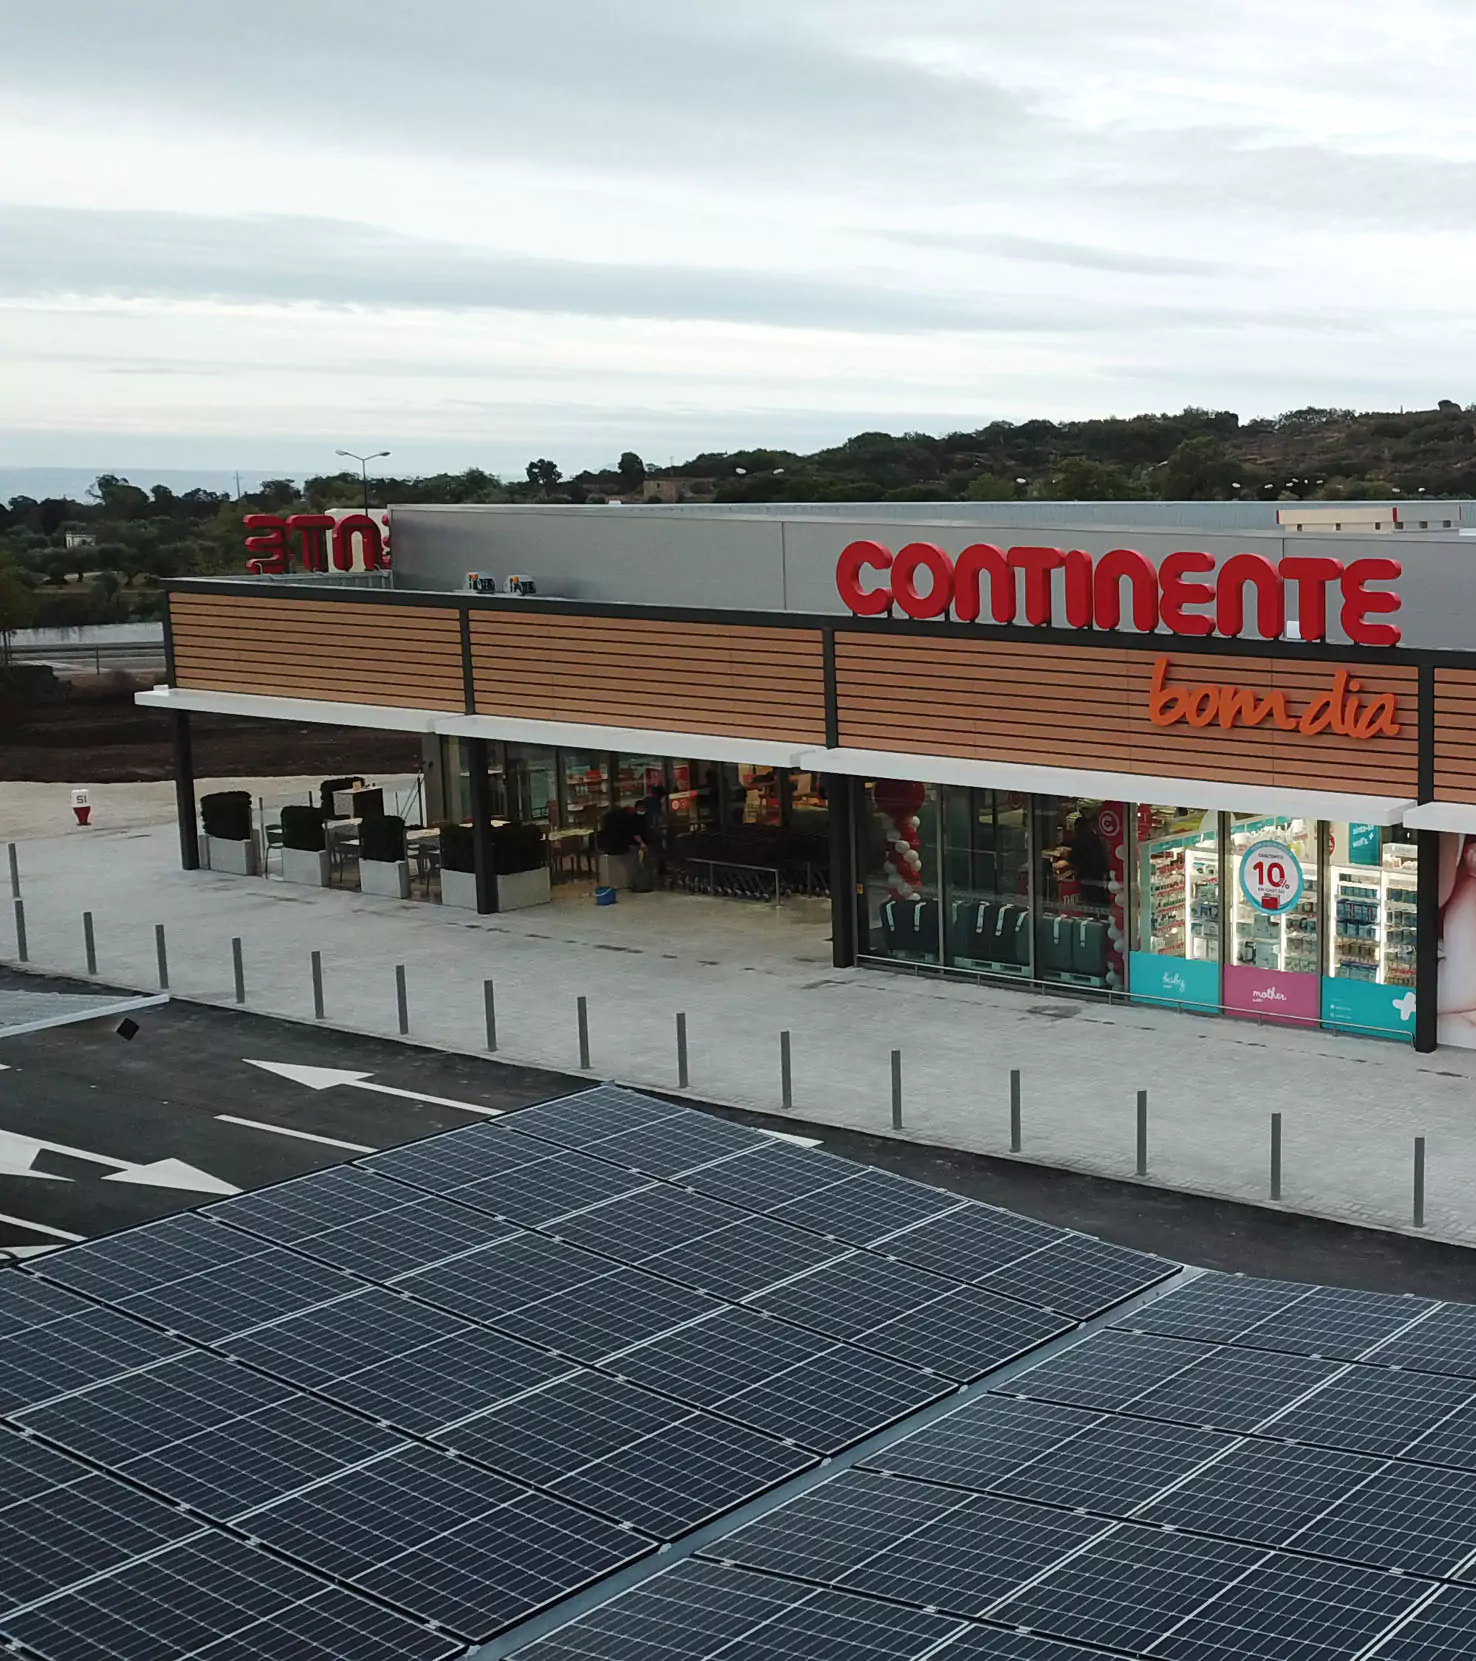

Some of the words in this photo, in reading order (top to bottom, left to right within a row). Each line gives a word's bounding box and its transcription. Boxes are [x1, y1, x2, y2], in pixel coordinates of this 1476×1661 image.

[836, 540, 1401, 645] CONTINENTE
[1149, 657, 1298, 730] bom
[1299, 668, 1401, 739] dia
[1252, 861, 1290, 890] 10%
[1162, 972, 1186, 993] baby
[1253, 986, 1287, 1001] mother
